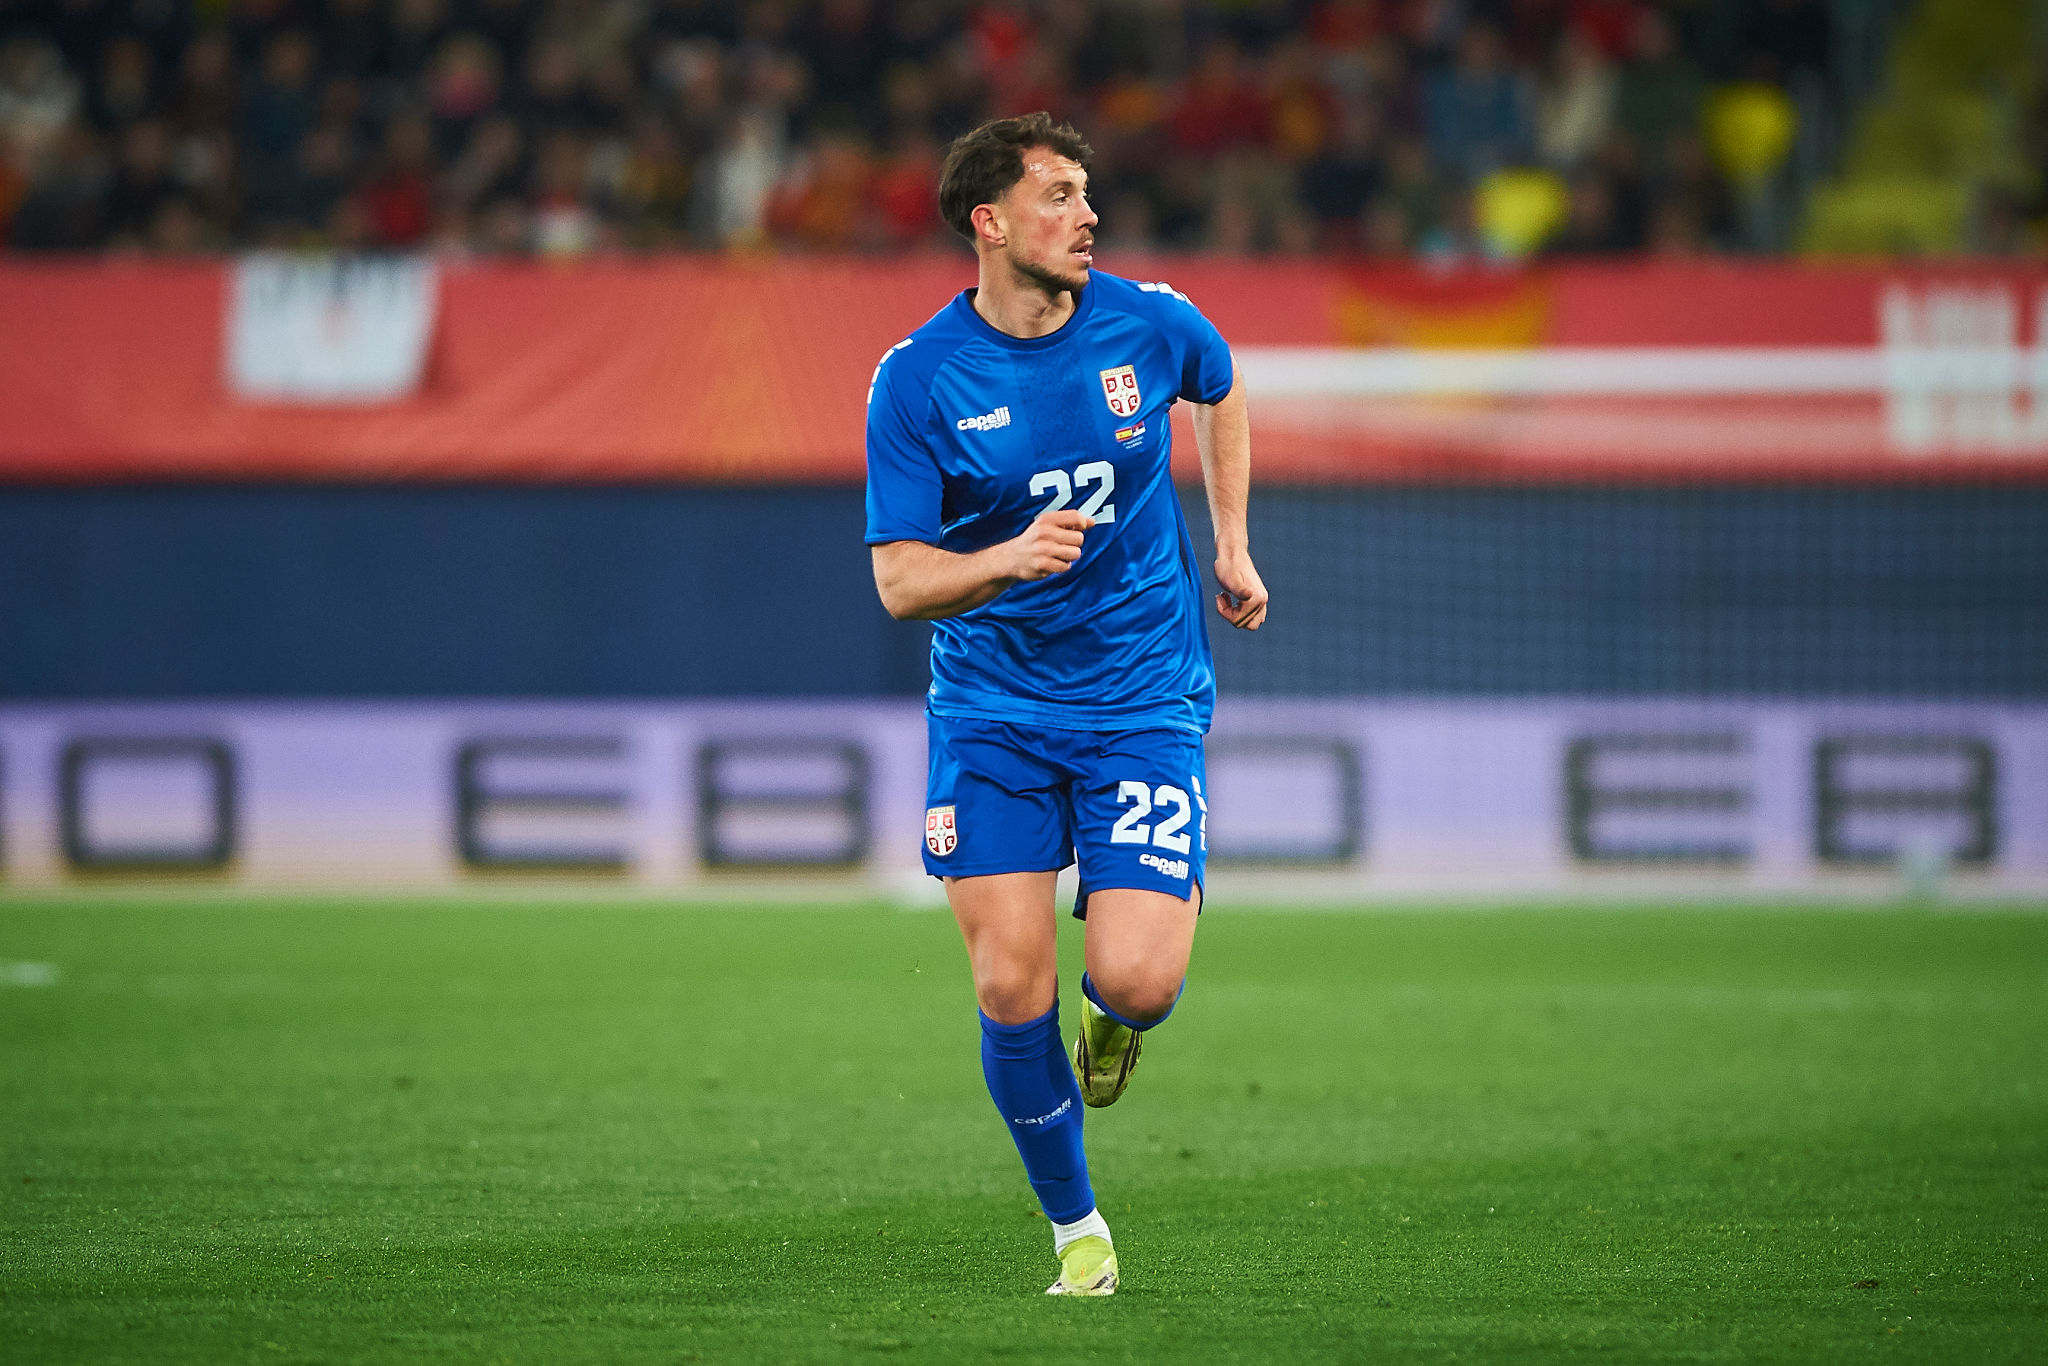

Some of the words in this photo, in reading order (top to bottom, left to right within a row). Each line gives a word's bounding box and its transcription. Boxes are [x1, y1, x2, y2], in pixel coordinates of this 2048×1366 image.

[957, 406, 1011, 431] capelli
[983, 419, 1012, 431] SPORT
[1029, 460, 1116, 524] 22
[1110, 780, 1191, 855] 22
[1139, 853, 1189, 878] capelli
[1014, 1097, 1072, 1125] capelli
